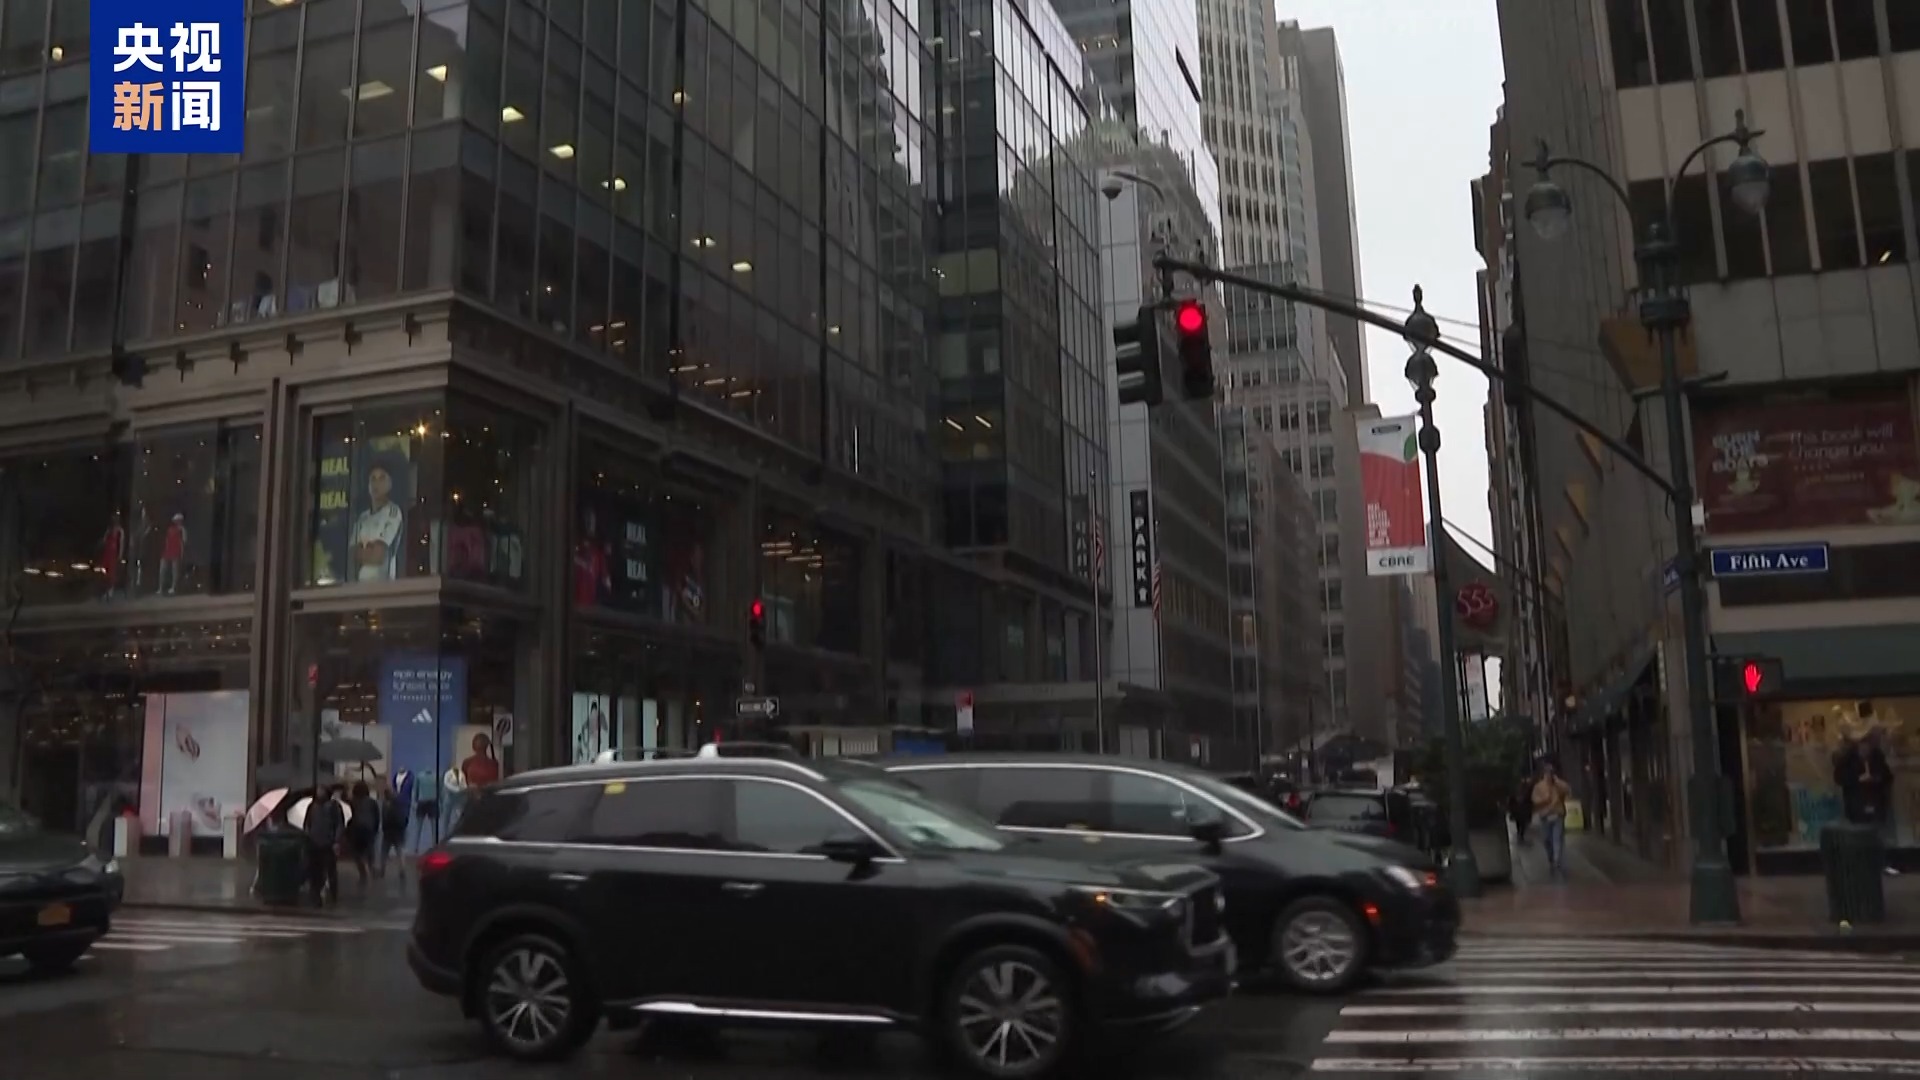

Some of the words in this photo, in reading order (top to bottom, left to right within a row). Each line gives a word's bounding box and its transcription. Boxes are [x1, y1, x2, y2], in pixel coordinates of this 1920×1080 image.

[1134, 516, 1147, 581] PARK
[1730, 553, 1771, 570] Fifth
[1776, 552, 1809, 569] Ave
